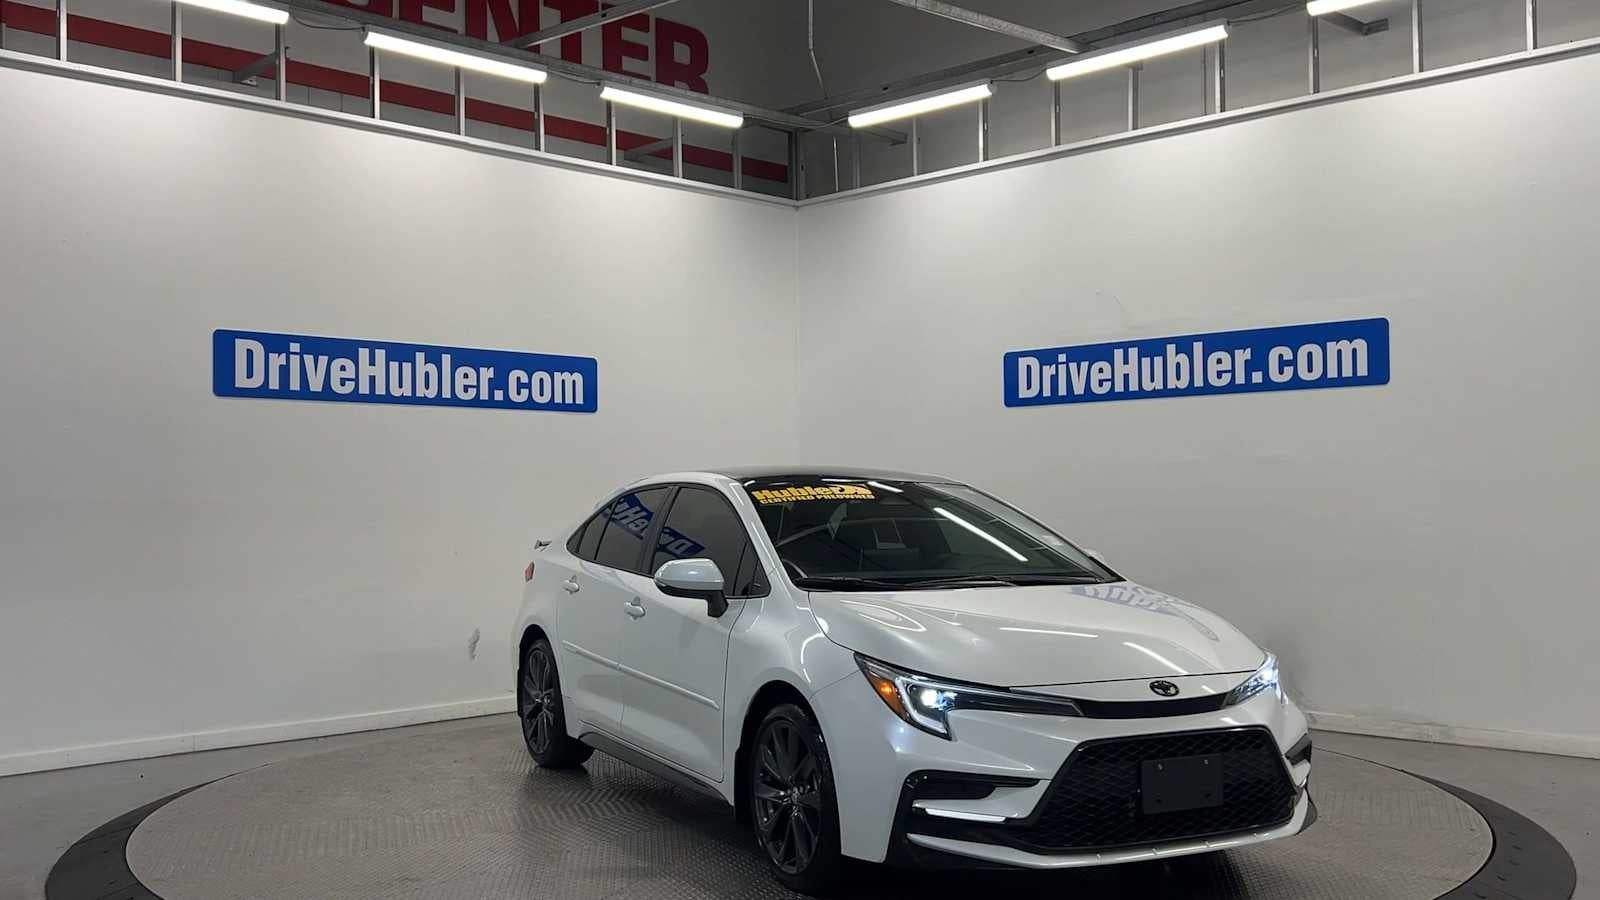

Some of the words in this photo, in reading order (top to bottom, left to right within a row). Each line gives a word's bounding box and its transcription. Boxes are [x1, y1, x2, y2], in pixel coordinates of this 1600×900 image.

[321, 0, 709, 94] ENTER
[234, 337, 584, 405] DriveHubler.com
[1017, 337, 1369, 399] DriveHubler.com
